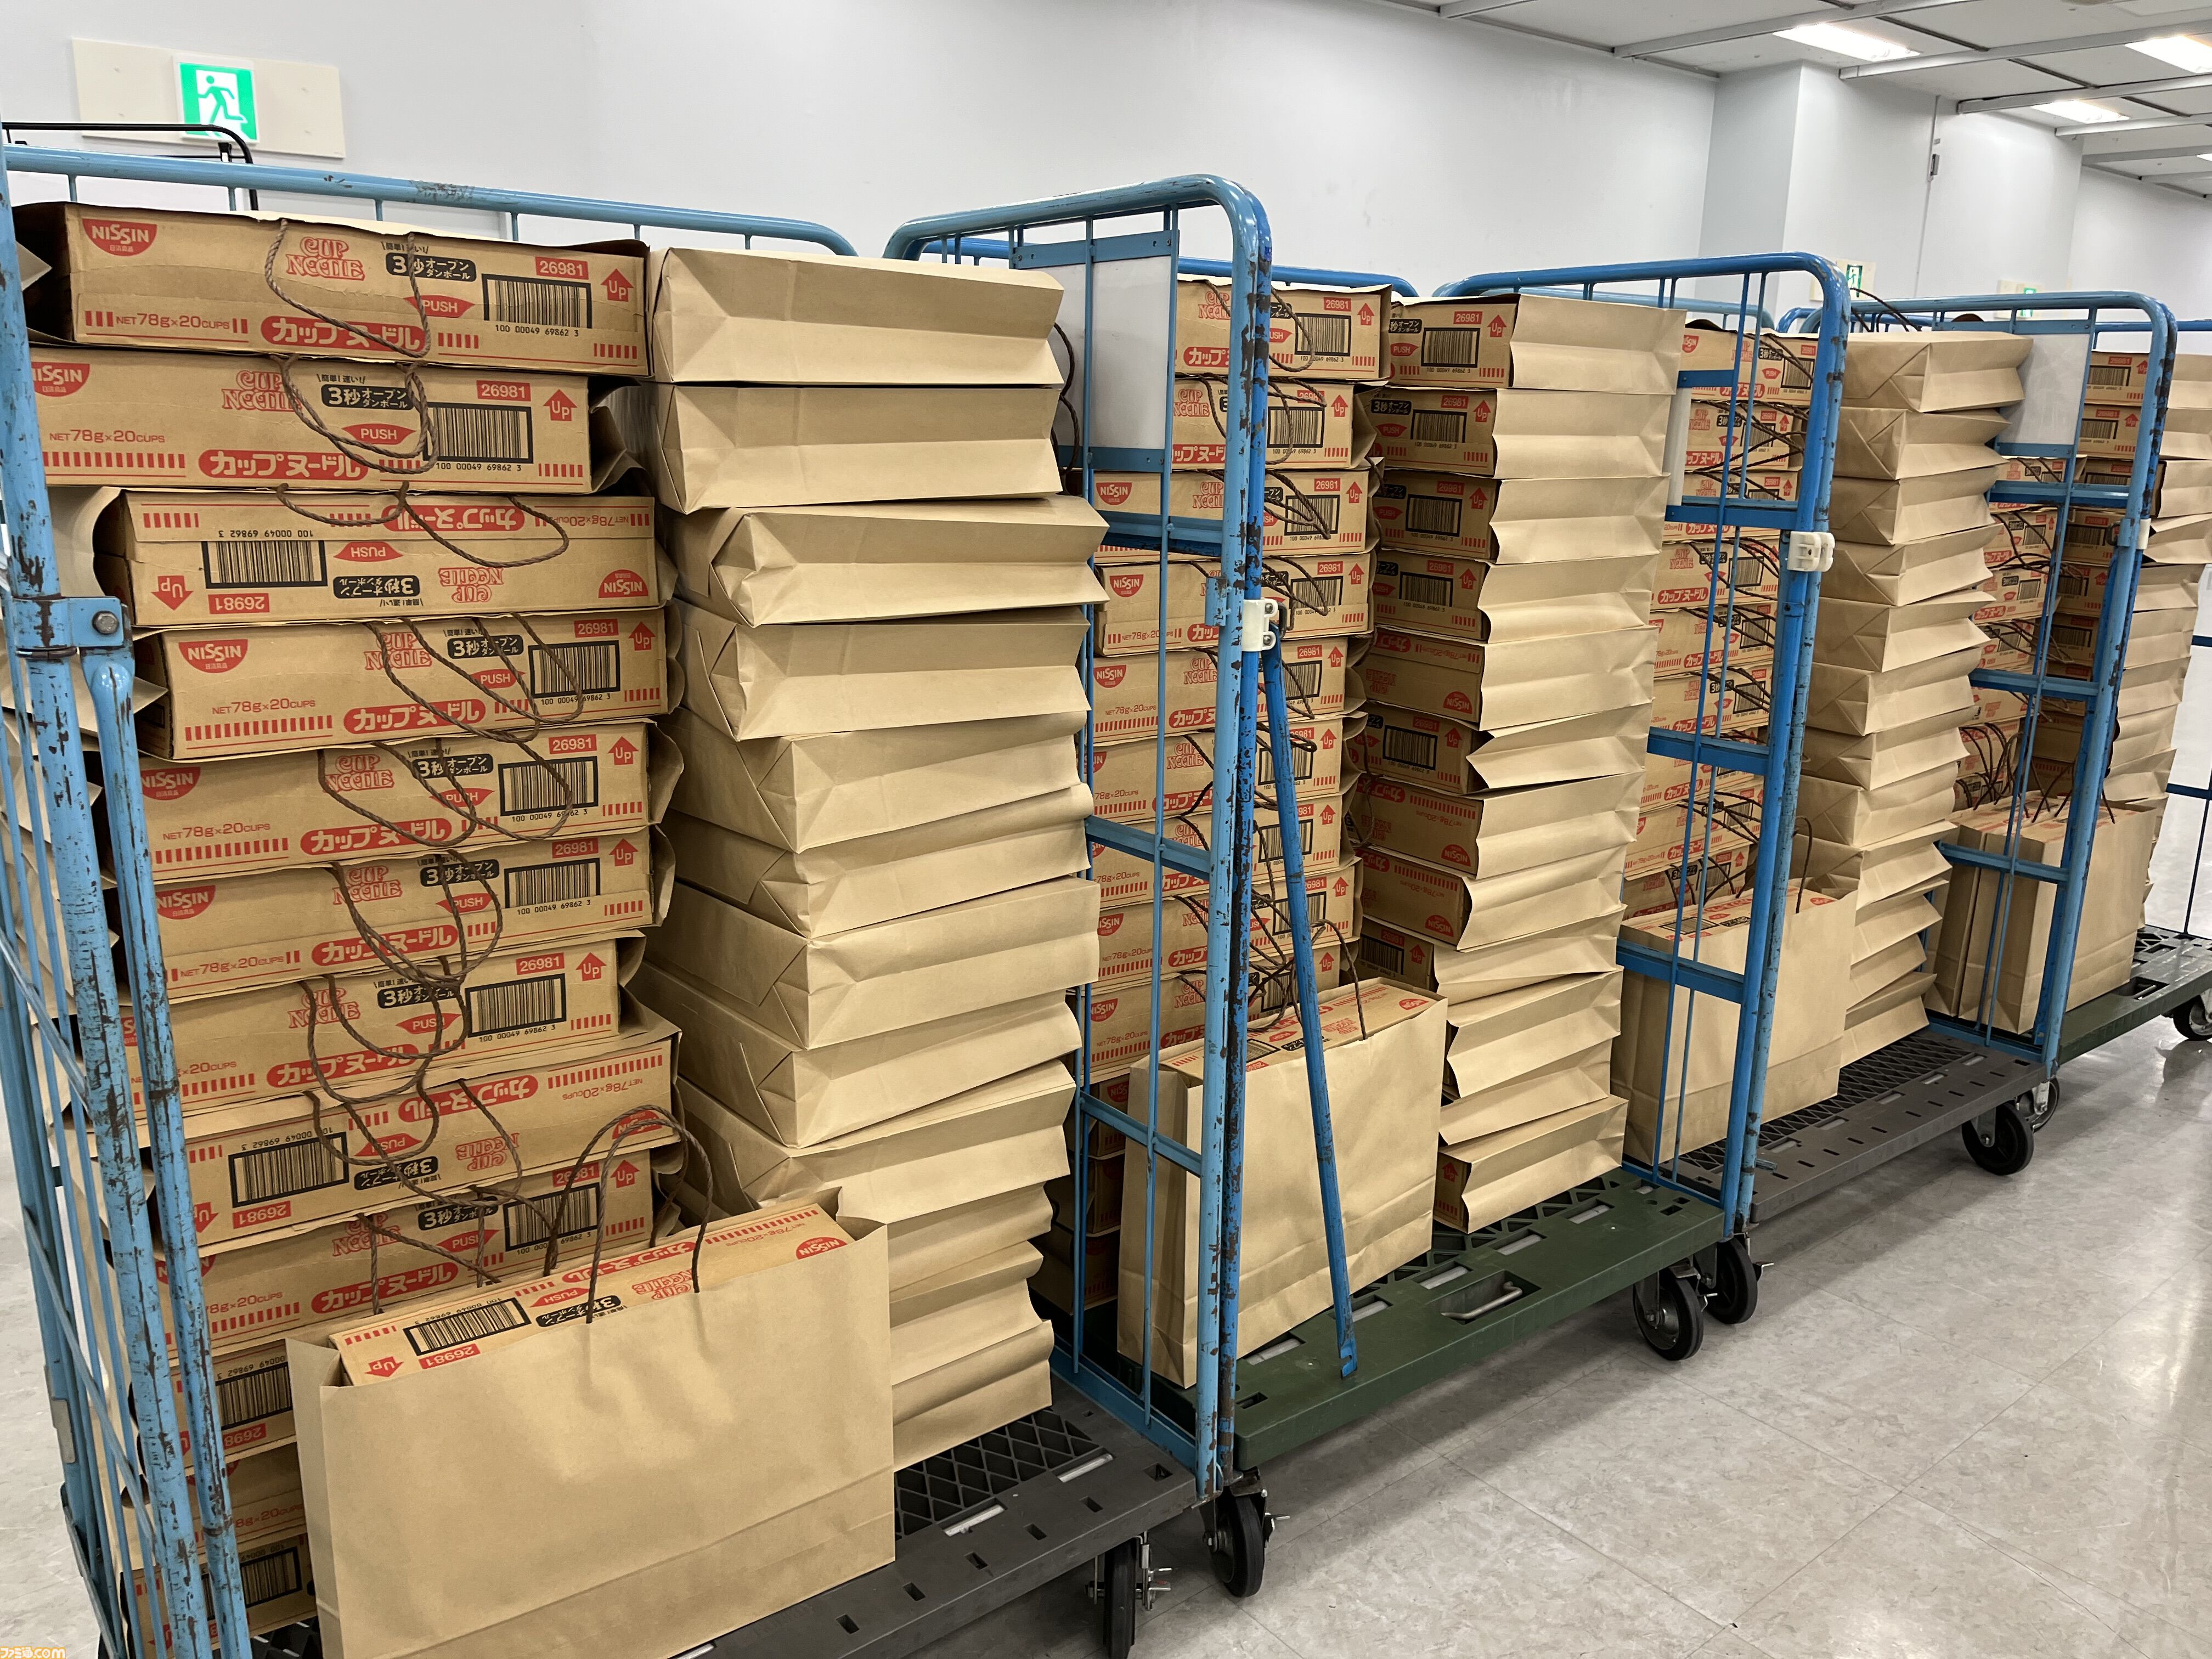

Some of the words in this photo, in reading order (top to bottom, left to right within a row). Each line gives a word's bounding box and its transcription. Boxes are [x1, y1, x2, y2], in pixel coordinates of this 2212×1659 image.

[92, 224, 149, 245] NISSIN
[300, 237, 349, 258] CUP
[425, 259, 469, 272] オープン
[539, 260, 584, 276] 26981
[426, 269, 471, 281] ダンボール
[608, 282, 627, 299] UP
[423, 300, 458, 313] PUSH
[1326, 300, 1348, 309] 26981
[1362, 313, 1371, 324] UP
[1456, 313, 1479, 323] 26981
[515, 325, 540, 335] 00049
[545, 327, 569, 337] 69862
[574, 329, 579, 337] 3
[1492, 323, 1502, 335] UP
[1393, 346, 1410, 354] PUSH
[236, 370, 283, 390] CUP
[329, 387, 360, 406] 3秒
[362, 389, 406, 400] オープン
[481, 384, 526, 398] 26981
[1179, 390, 1203, 403] CUP
[363, 399, 408, 409] ダンボール
[551, 400, 569, 418] UP
[1443, 398, 1466, 407] 26981
[1335, 404, 1344, 416] UP
[1477, 409, 1487, 420] UP
[361, 428, 397, 440] PUSH
[210, 452, 360, 479] カップヌードル
[487, 464, 511, 472] 69862
[1100, 484, 1128, 498] NISSIN
[1316, 481, 1338, 490] 26981
[1438, 484, 1462, 493] 26981
[1350, 490, 1359, 500] UP
[398, 508, 516, 531] カップヌードル
[351, 546, 386, 557] PUSH
[1319, 563, 1341, 573] 26981
[1429, 562, 1452, 572] 26981
[1114, 577, 1139, 589] NISSIN
[1352, 572, 1361, 582] UP
[161, 579, 183, 598] UP
[340, 586, 383, 596] オープン
[383, 577, 414, 595] 3秒
[604, 579, 642, 594] NISSIN
[452, 585, 492, 603] CUP
[216, 596, 264, 611] 26981
[578, 623, 614, 635] 26981
[635, 632, 649, 647] UP
[188, 644, 241, 662] NISSIN
[454, 639, 479, 657] 3秒
[1299, 647, 1321, 657] 26981
[1331, 654, 1340, 664] UP
[481, 674, 510, 684] PUSH
[1097, 668, 1122, 680] NISSIN
[1447, 697, 1470, 710] NISSIN
[1675, 715, 1716, 731] カップードル
[552, 738, 592, 752] 26981
[1324, 736, 1333, 746] UP
[616, 748, 631, 762] UP
[336, 755, 380, 774] CUP
[418, 759, 443, 777] 3秒
[447, 757, 487, 767] オープン
[142, 771, 193, 789] NISSIN
[447, 792, 478, 804] PUH
[530, 812, 552, 821] 00049
[1323, 812, 1332, 822] UP
[556, 842, 593, 855] 26981
[616, 850, 631, 864] UP
[1444, 850, 1468, 863] NISSIN
[347, 866, 388, 886] CUP
[1336, 885, 1345, 895] UP
[455, 897, 483, 909] PUSH
[561, 901, 582, 910] 69862
[1099, 917, 1120, 929] ISSIN
[1428, 921, 1451, 933] NISSIN
[520, 958, 561, 972] 26981
[1323, 959, 1331, 968] UP
[583, 964, 599, 978] UP
[384, 988, 413, 1007] 3秒
[497, 1030, 520, 1040] 00049
[525, 1026, 546, 1035] 69862
[286, 1131, 312, 1141] 00049
[253, 1138, 279, 1148] 69862
[404, 1157, 431, 1176] 3秒
[467, 1153, 507, 1171] CUP
[556, 1166, 596, 1184] 2681
[618, 1171, 633, 1185] UP
[239, 1204, 287, 1224] 26981
[424, 1209, 452, 1227] 3秒
[561, 1235, 582, 1244] 69862
[799, 1239, 840, 1255] NISSIN
[544, 1289, 578, 1304] PUSH
[651, 1283, 692, 1301] CUP
[456, 1303, 482, 1313] 00049
[426, 1311, 450, 1320] 69862
[259, 1356, 285, 1368] 00049
[426, 1345, 475, 1368] 26981
[228, 1364, 254, 1377] 69862
[371, 1358, 395, 1371] UP
[225, 1426, 262, 1444] 2698
